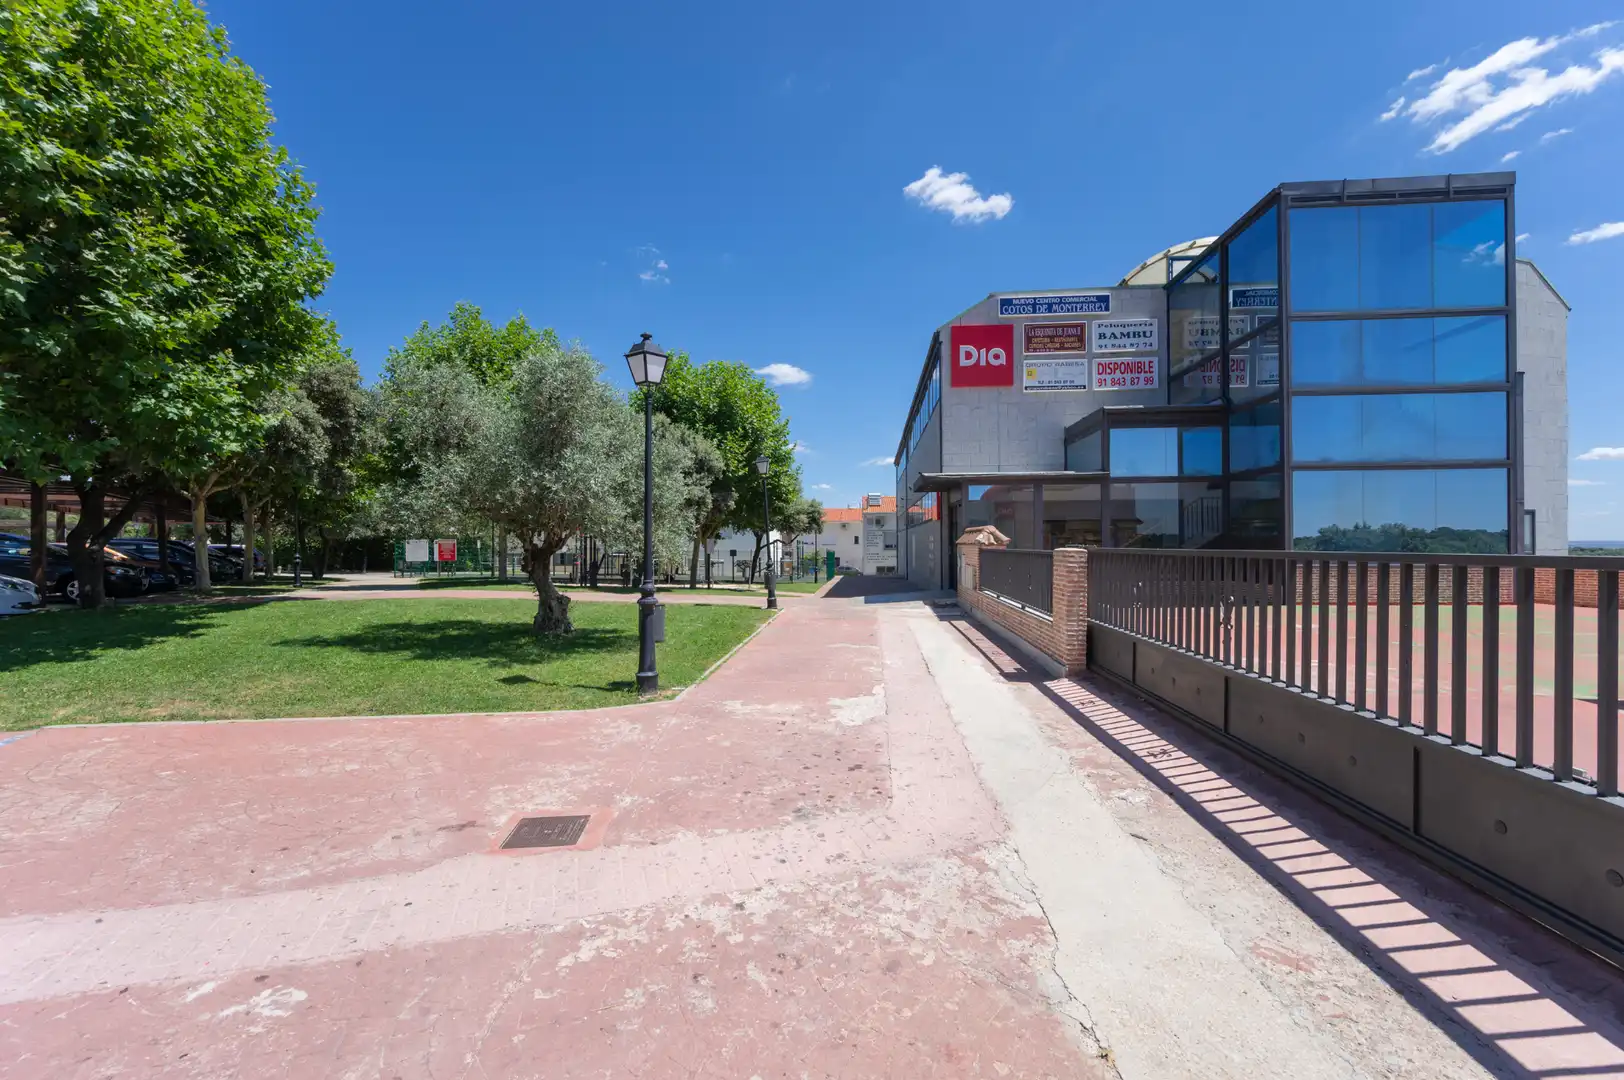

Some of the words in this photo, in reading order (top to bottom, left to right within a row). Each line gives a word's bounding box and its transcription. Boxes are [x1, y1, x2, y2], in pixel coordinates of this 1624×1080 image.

[1002, 305, 1033, 314] COTOS
[1036, 304, 1048, 314] DE
[1052, 303, 1107, 313] MONTERREY
[1098, 331, 1153, 340] BAMBU
[1097, 360, 1154, 375] DISPONIBLE
[1097, 377, 1107, 387] 91
[1110, 377, 1126, 387] 843
[1130, 376, 1140, 386] 87
[1143, 376, 1154, 385] 99
